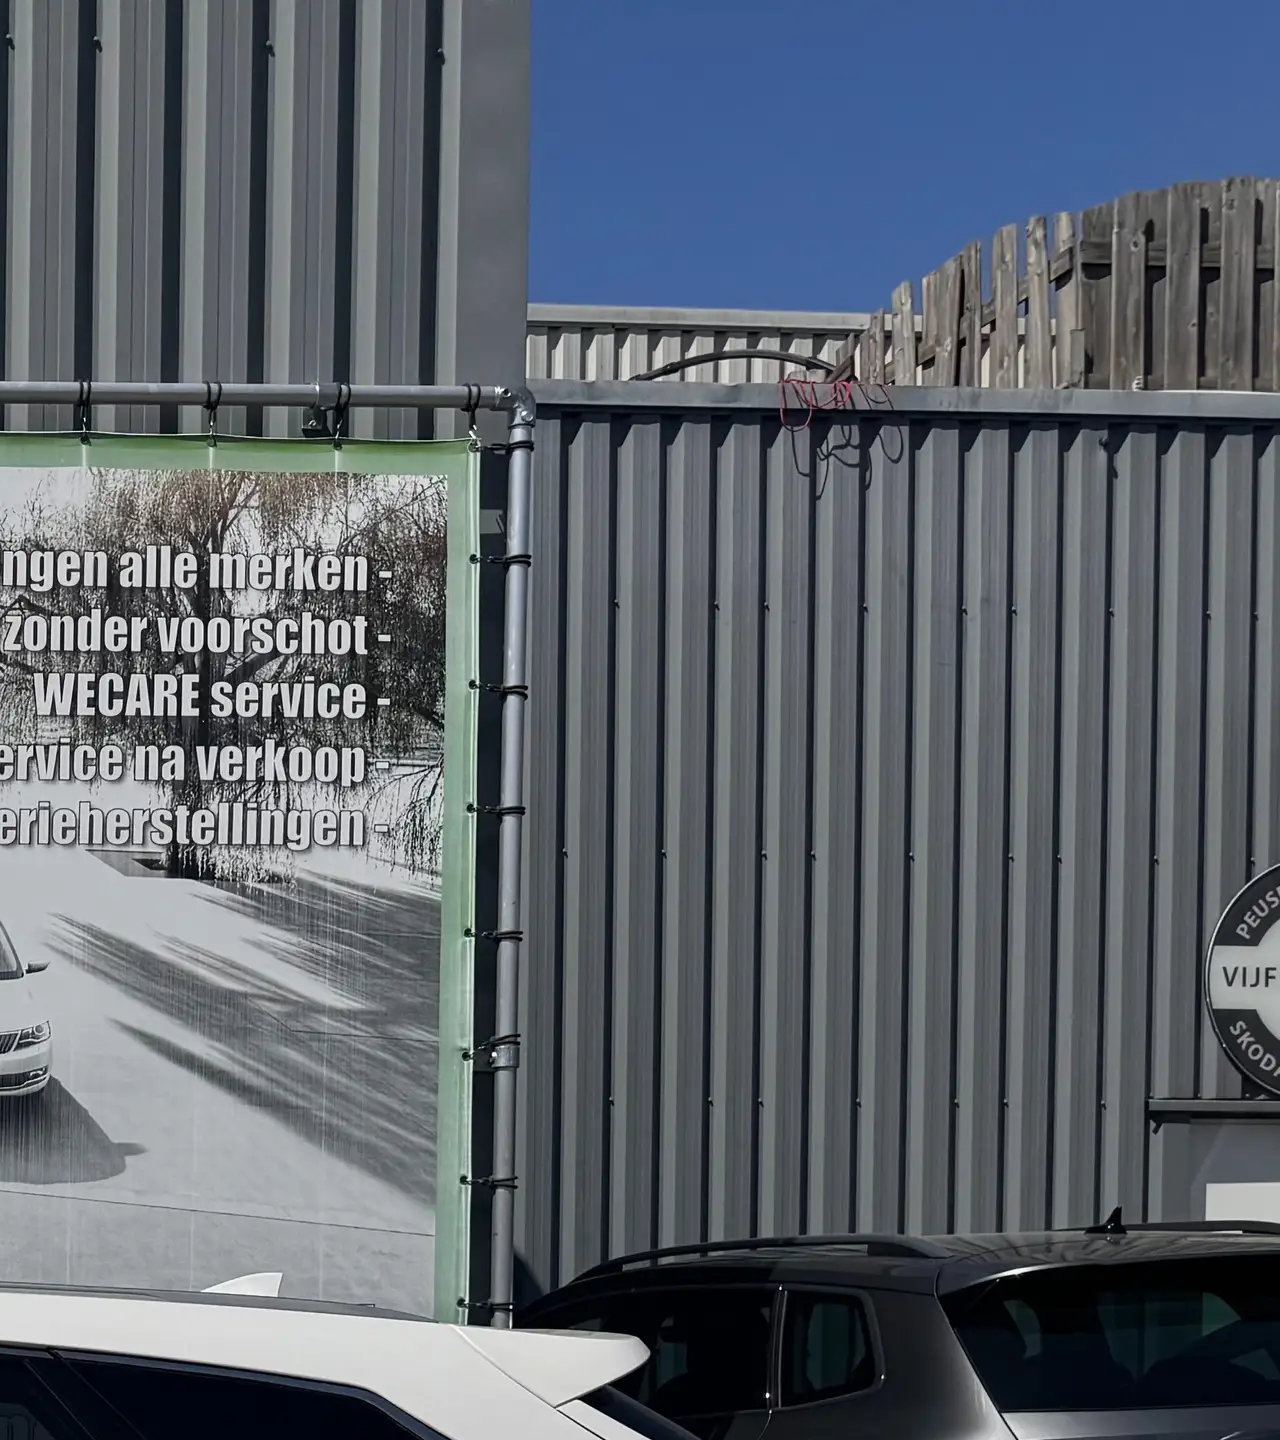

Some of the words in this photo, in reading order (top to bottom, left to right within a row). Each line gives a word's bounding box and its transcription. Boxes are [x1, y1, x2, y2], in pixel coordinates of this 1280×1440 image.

[119, 545, 197, 590] alle
[210, 547, 368, 592] merken
[3, 608, 146, 653] zonder
[157, 612, 368, 656] voorschot
[33, 673, 199, 718] WECARE
[210, 677, 367, 720] service
[133, 743, 184, 782] na
[196, 740, 365, 786] verkoop
[1236, 886, 1280, 939] PEUS
[1222, 966, 1277, 987] VIJF
